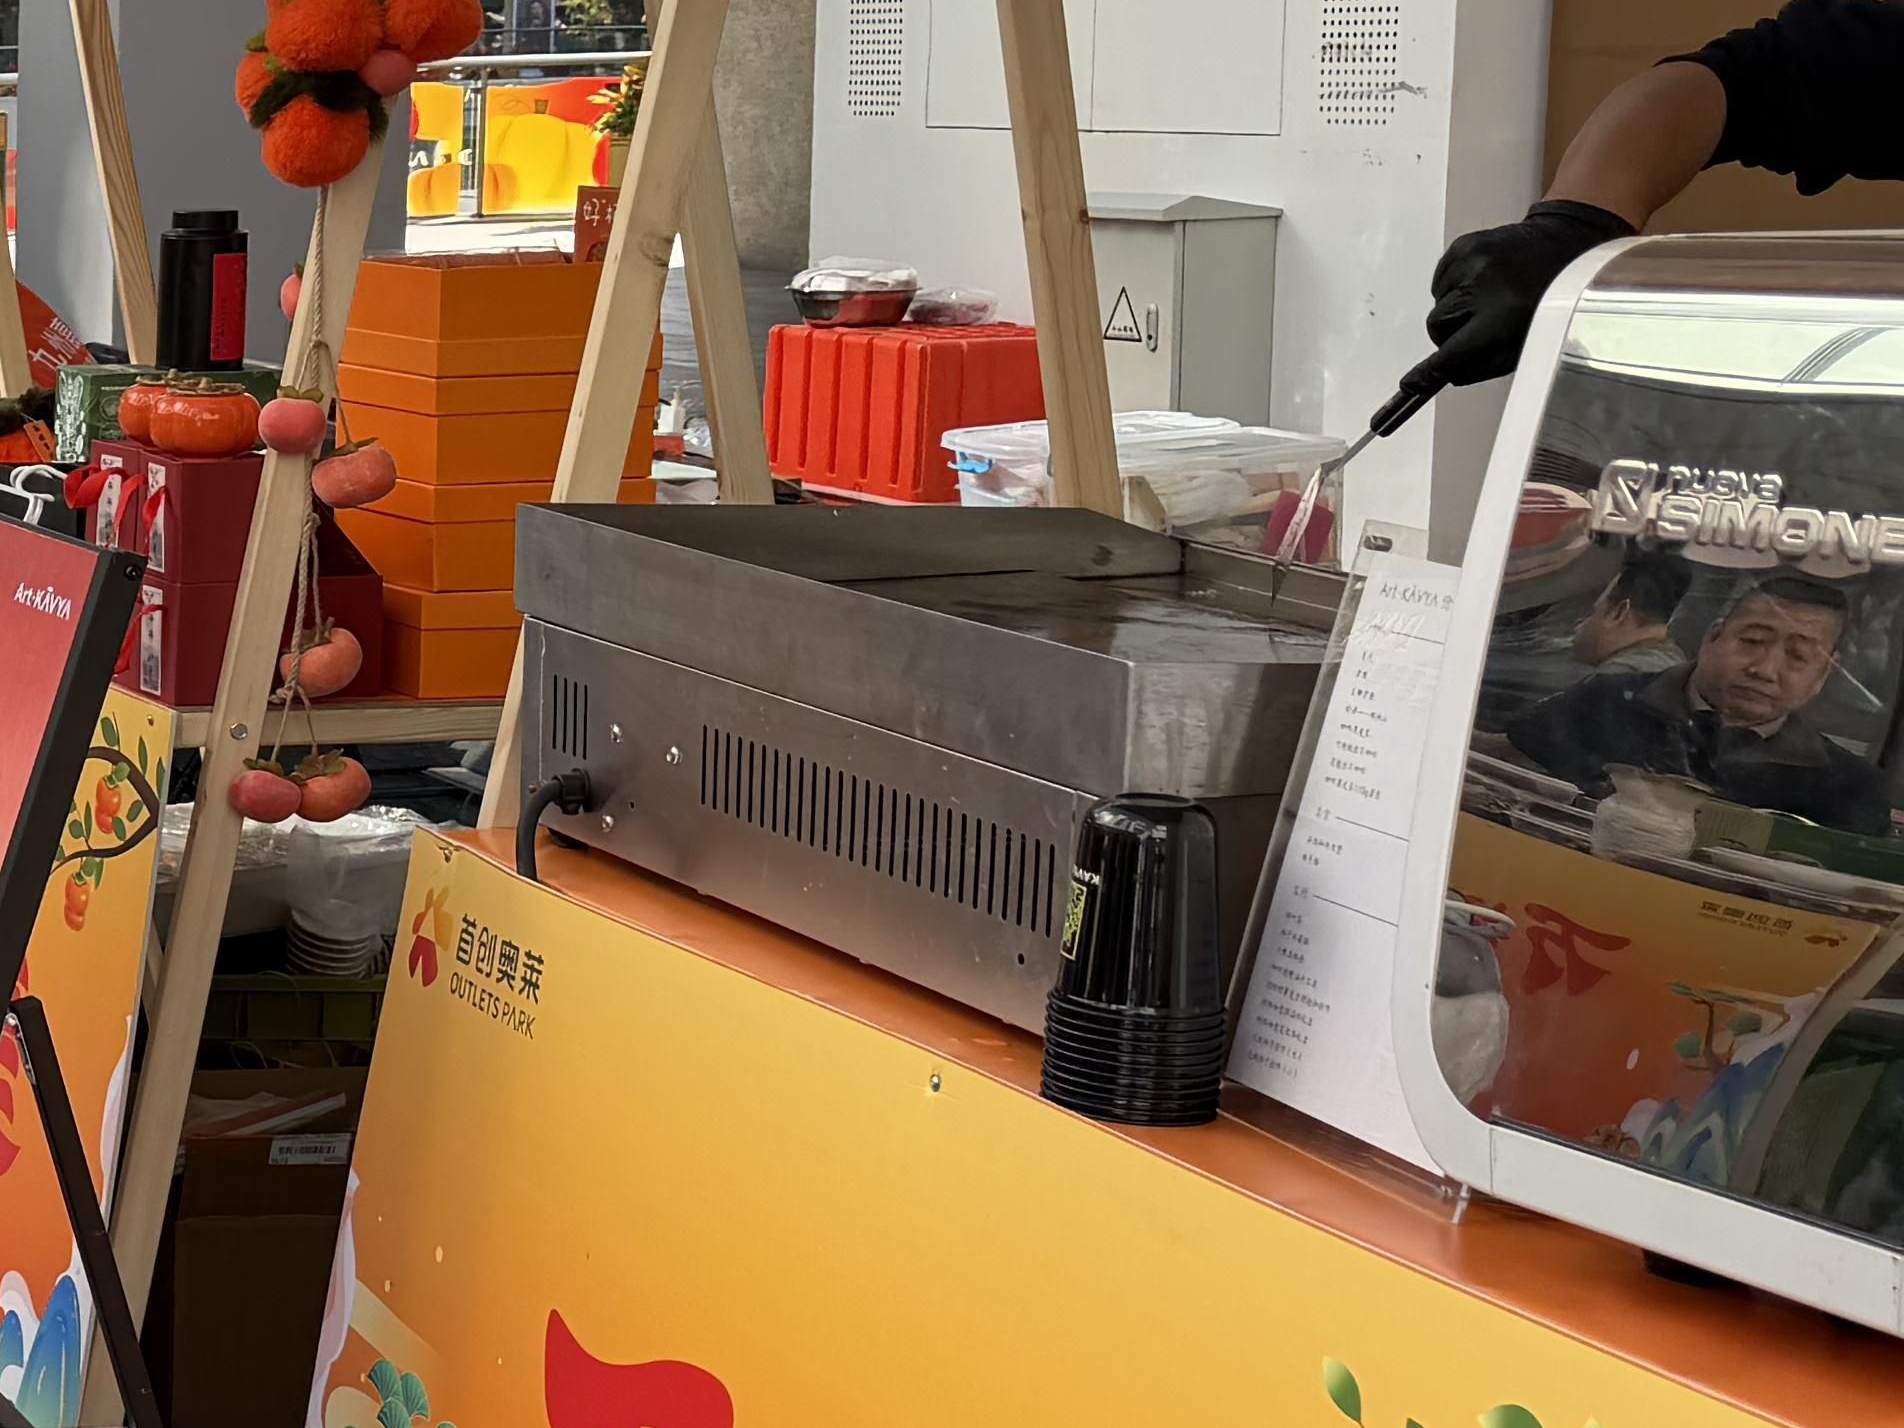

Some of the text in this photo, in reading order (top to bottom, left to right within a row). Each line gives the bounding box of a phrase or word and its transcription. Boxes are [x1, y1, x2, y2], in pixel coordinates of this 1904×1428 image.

[456, 913, 544, 1004] 首创奥莱
[450, 972, 536, 1039] OUTLETS PARK
